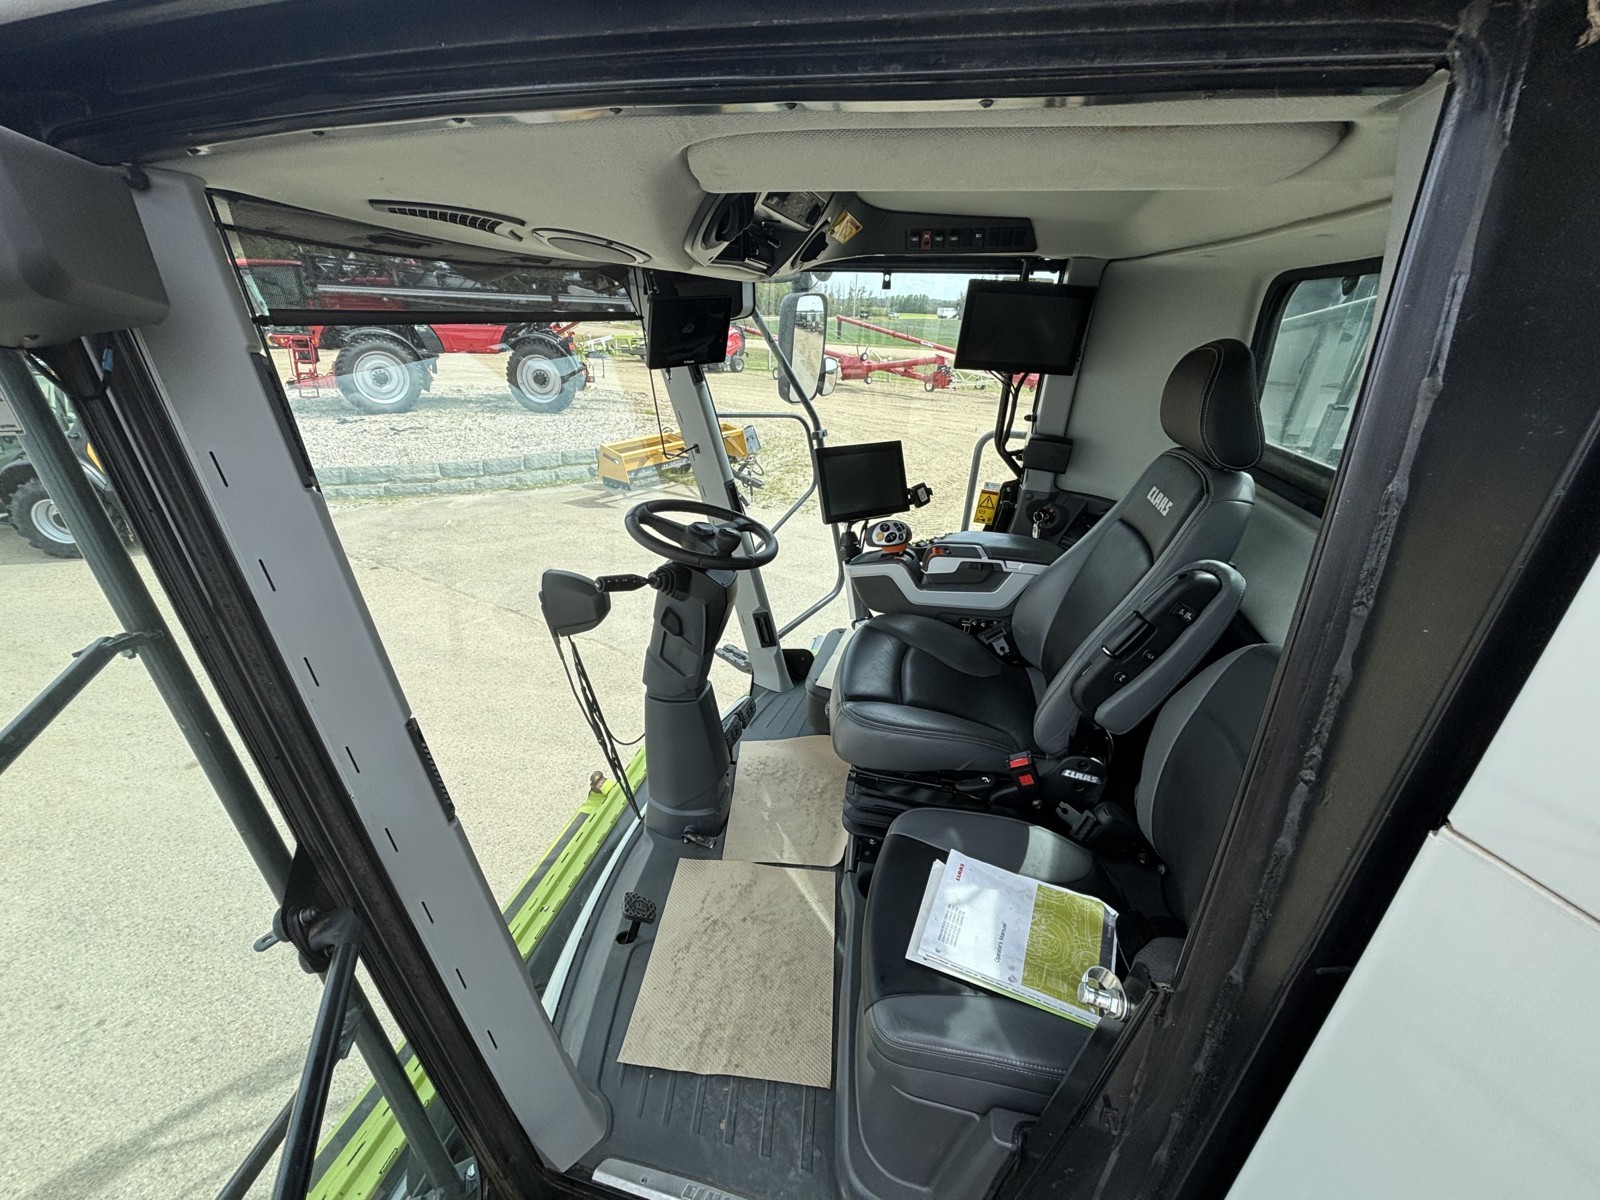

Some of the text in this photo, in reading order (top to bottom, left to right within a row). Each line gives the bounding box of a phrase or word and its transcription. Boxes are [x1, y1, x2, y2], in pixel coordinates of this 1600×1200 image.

[1146, 485, 1174, 517] CLAAS
[1063, 769, 1099, 783] CLAAS
[956, 863, 965, 881] CLAAS
[994, 921, 1007, 963] Operator's Manual
